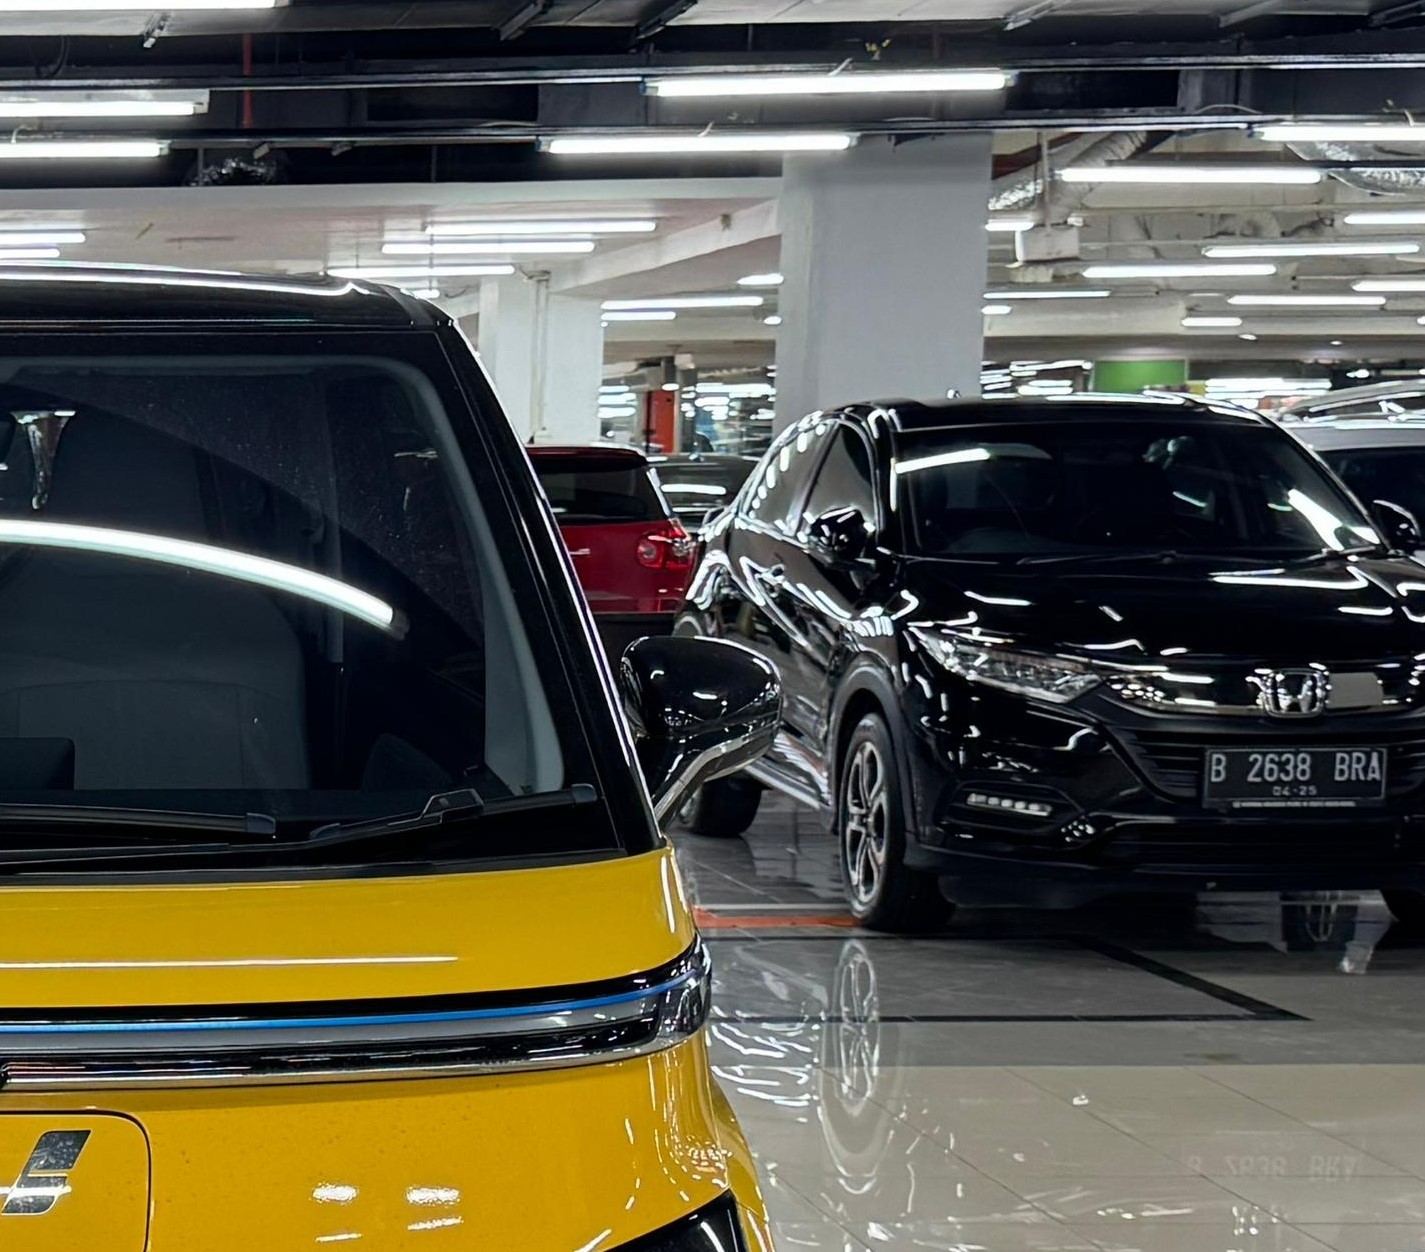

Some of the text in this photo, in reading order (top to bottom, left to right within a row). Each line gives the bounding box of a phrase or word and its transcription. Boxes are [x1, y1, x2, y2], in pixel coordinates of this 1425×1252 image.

[1210, 752, 1381, 782] B 2638 BRA
